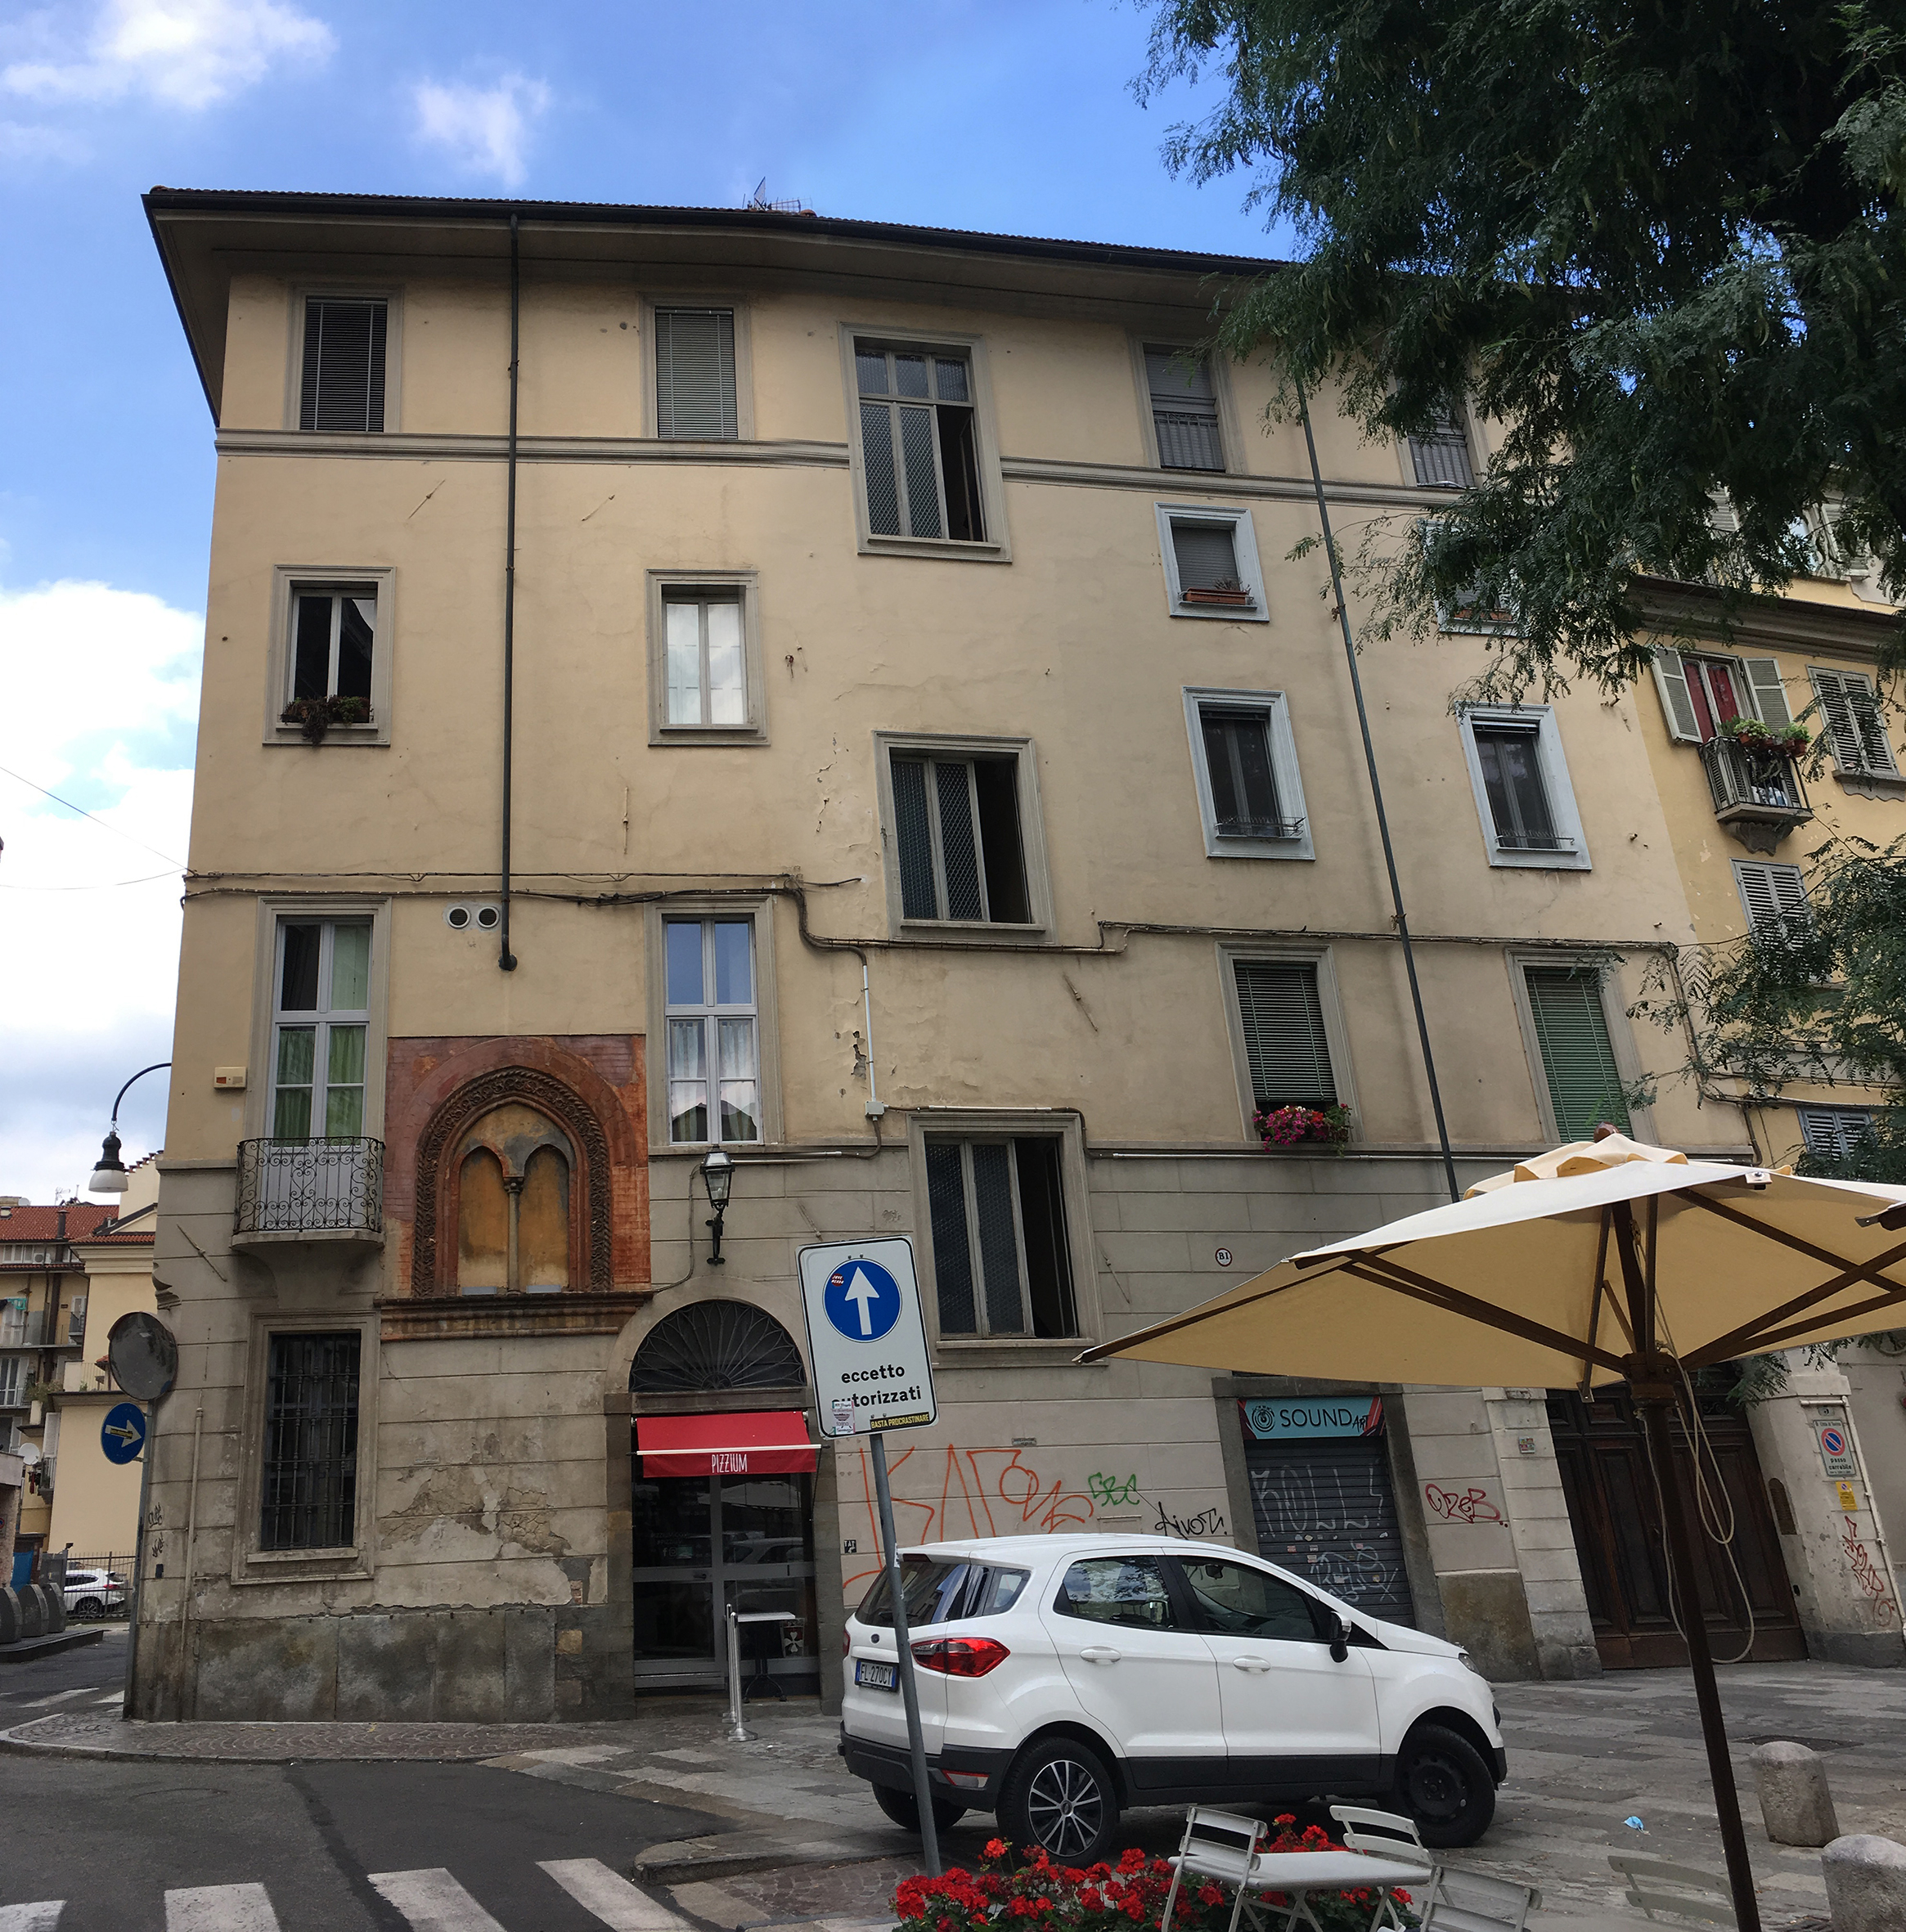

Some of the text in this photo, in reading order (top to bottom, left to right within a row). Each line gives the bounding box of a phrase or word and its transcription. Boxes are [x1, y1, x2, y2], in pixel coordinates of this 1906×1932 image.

[841, 1364, 905, 1383] eccetto
[831, 1386, 922, 1408] torizzati
[870, 1413, 929, 1429] BASTA PROCRASTINARE
[1279, 1409, 1370, 1432] SOUND ART
[711, 1453, 748, 1473] PIZZIUM
